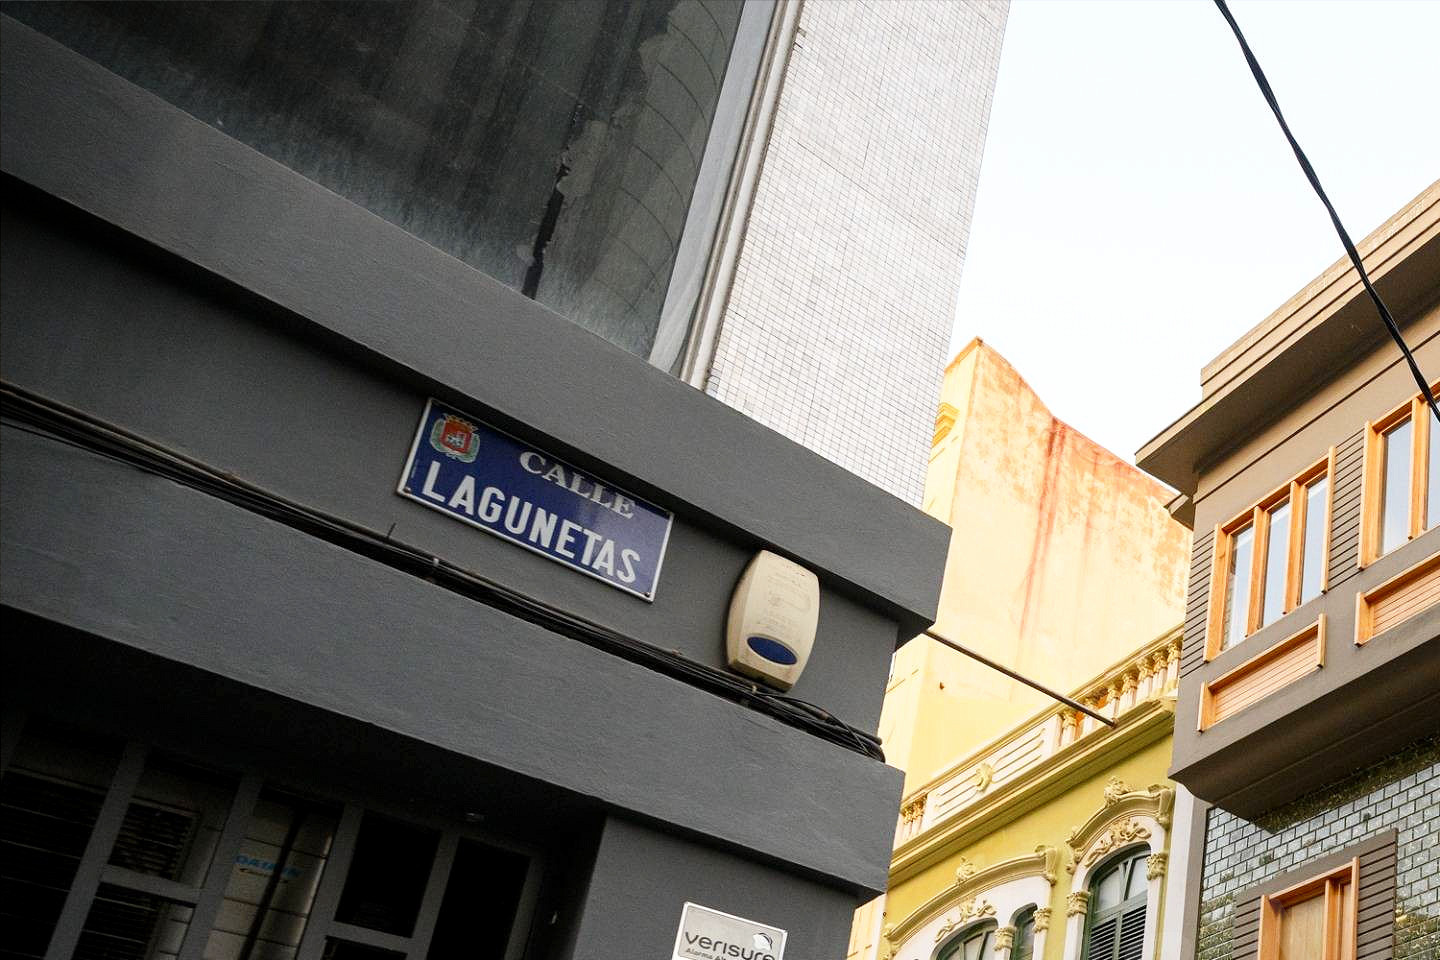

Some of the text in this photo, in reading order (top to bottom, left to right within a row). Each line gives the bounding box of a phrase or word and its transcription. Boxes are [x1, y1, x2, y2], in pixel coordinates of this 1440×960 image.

[518, 450, 636, 520] CALLE
[421, 460, 641, 584] LAGUNETAS
[686, 947, 713, 960] Alarma
